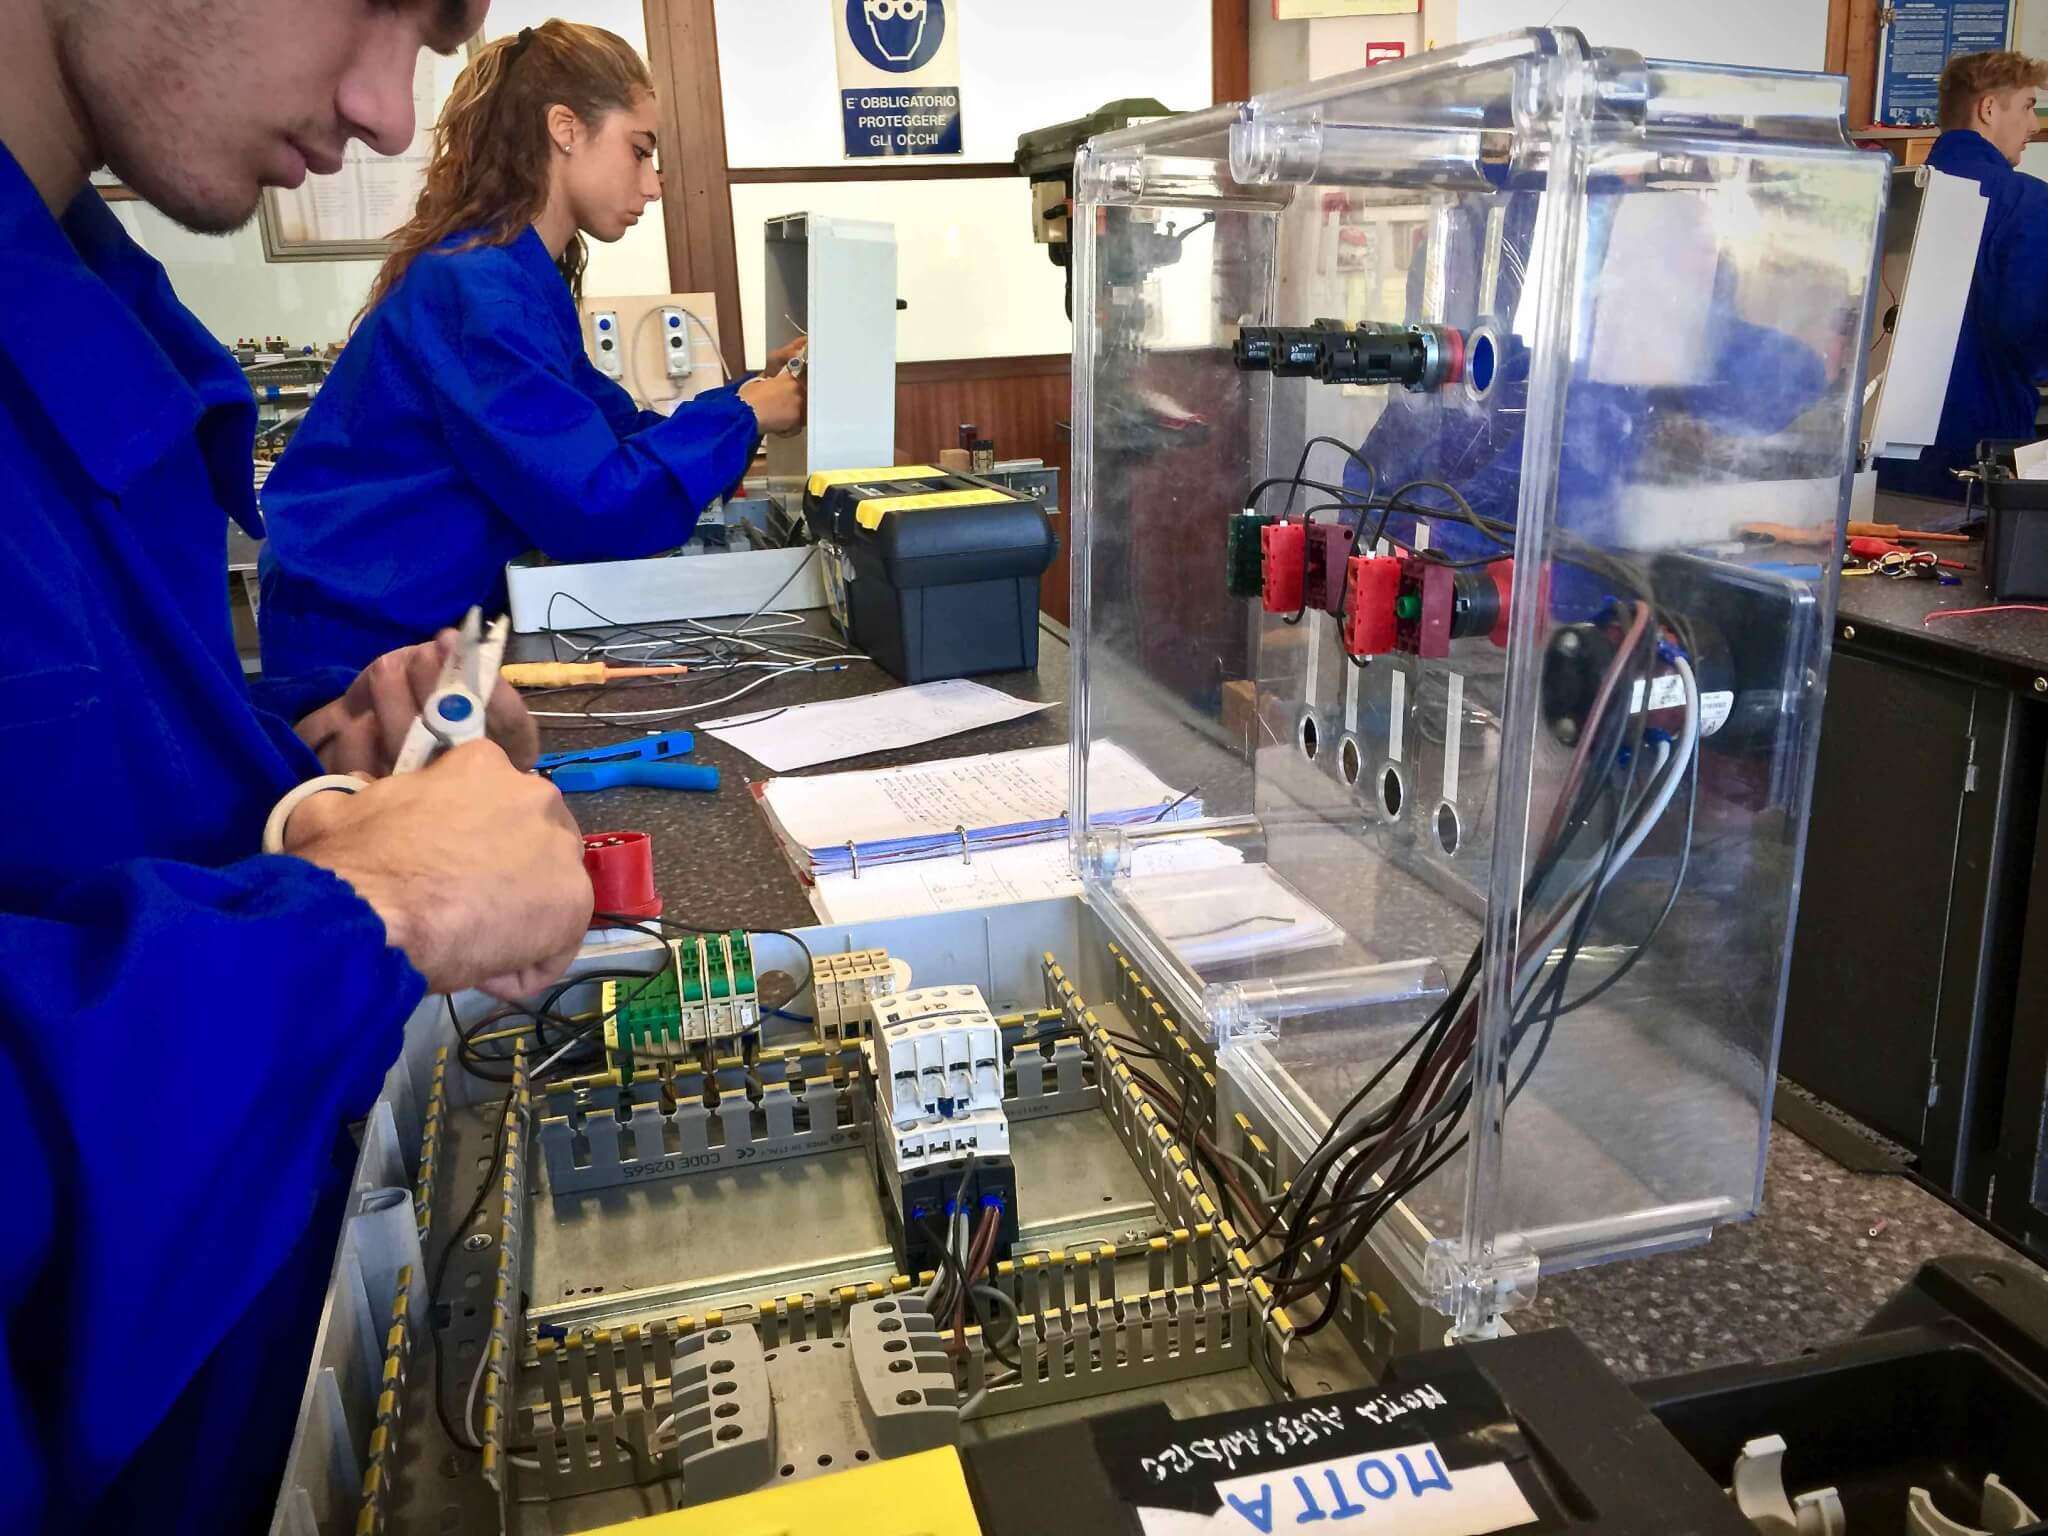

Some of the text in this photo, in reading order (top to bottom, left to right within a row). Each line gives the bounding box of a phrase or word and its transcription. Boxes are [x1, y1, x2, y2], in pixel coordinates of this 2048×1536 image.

[860, 95, 956, 109] OBBLIGATORIO
[858, 114, 947, 128] PROTEGGERE
[870, 134, 939, 147] GLI OCCHI
[680, 1152, 721, 1170] CODE
[1226, 1448, 1454, 1534] MOTTA
